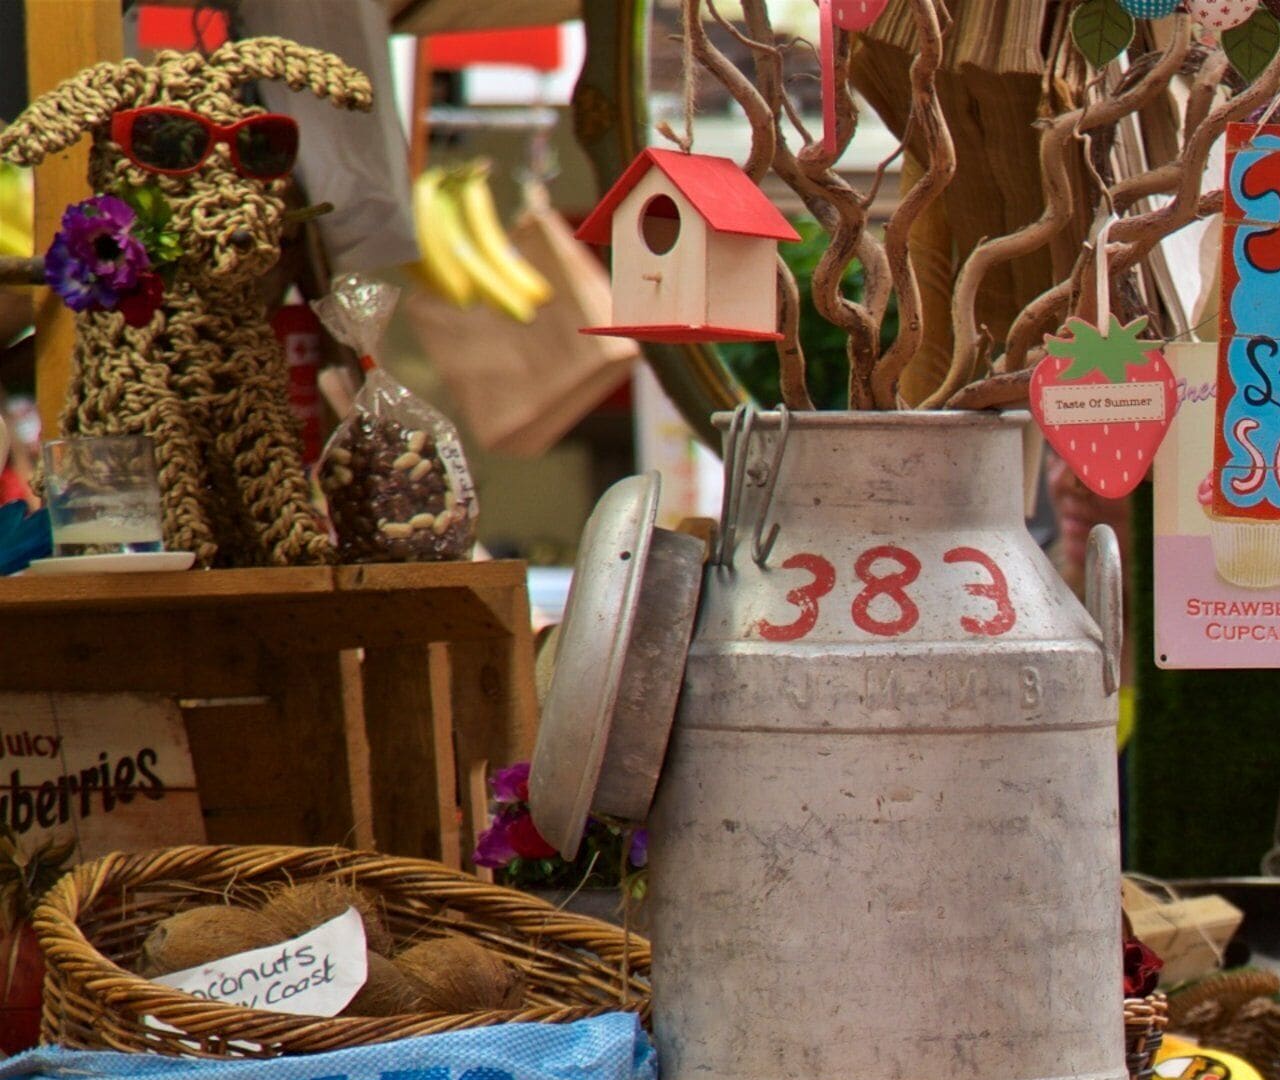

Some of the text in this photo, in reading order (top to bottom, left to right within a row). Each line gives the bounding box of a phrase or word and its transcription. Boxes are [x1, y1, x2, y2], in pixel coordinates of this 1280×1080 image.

[1056, 397, 1152, 410] Taste Of Summer
[758, 545, 1017, 642] 383
[178, 945, 316, 1001] oconuts
[265, 954, 336, 1006] Coast
